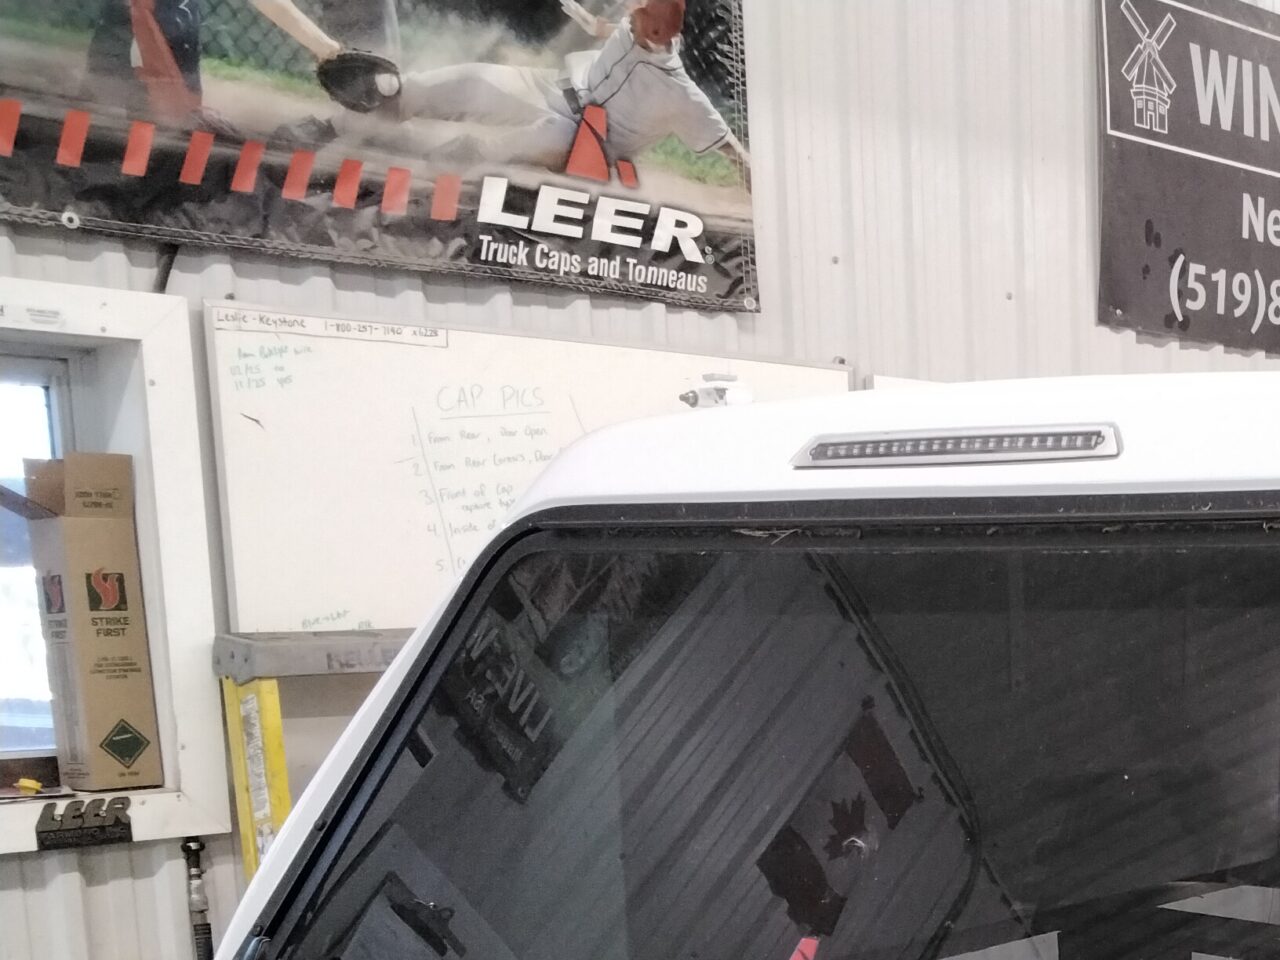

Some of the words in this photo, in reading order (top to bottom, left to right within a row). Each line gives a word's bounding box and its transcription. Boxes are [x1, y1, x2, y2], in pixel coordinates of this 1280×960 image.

[477, 176, 706, 264] LEER
[479, 235, 528, 266] Truck
[534, 243, 581, 277] Caps
[588, 256, 620, 279] and
[626, 257, 708, 293] Tonneaus
[437, 384, 484, 412] CAP
[500, 384, 545, 411] PICS
[91, 616, 130, 627] STRIKE
[96, 627, 127, 638] FIRST
[35, 797, 131, 832] LEER
